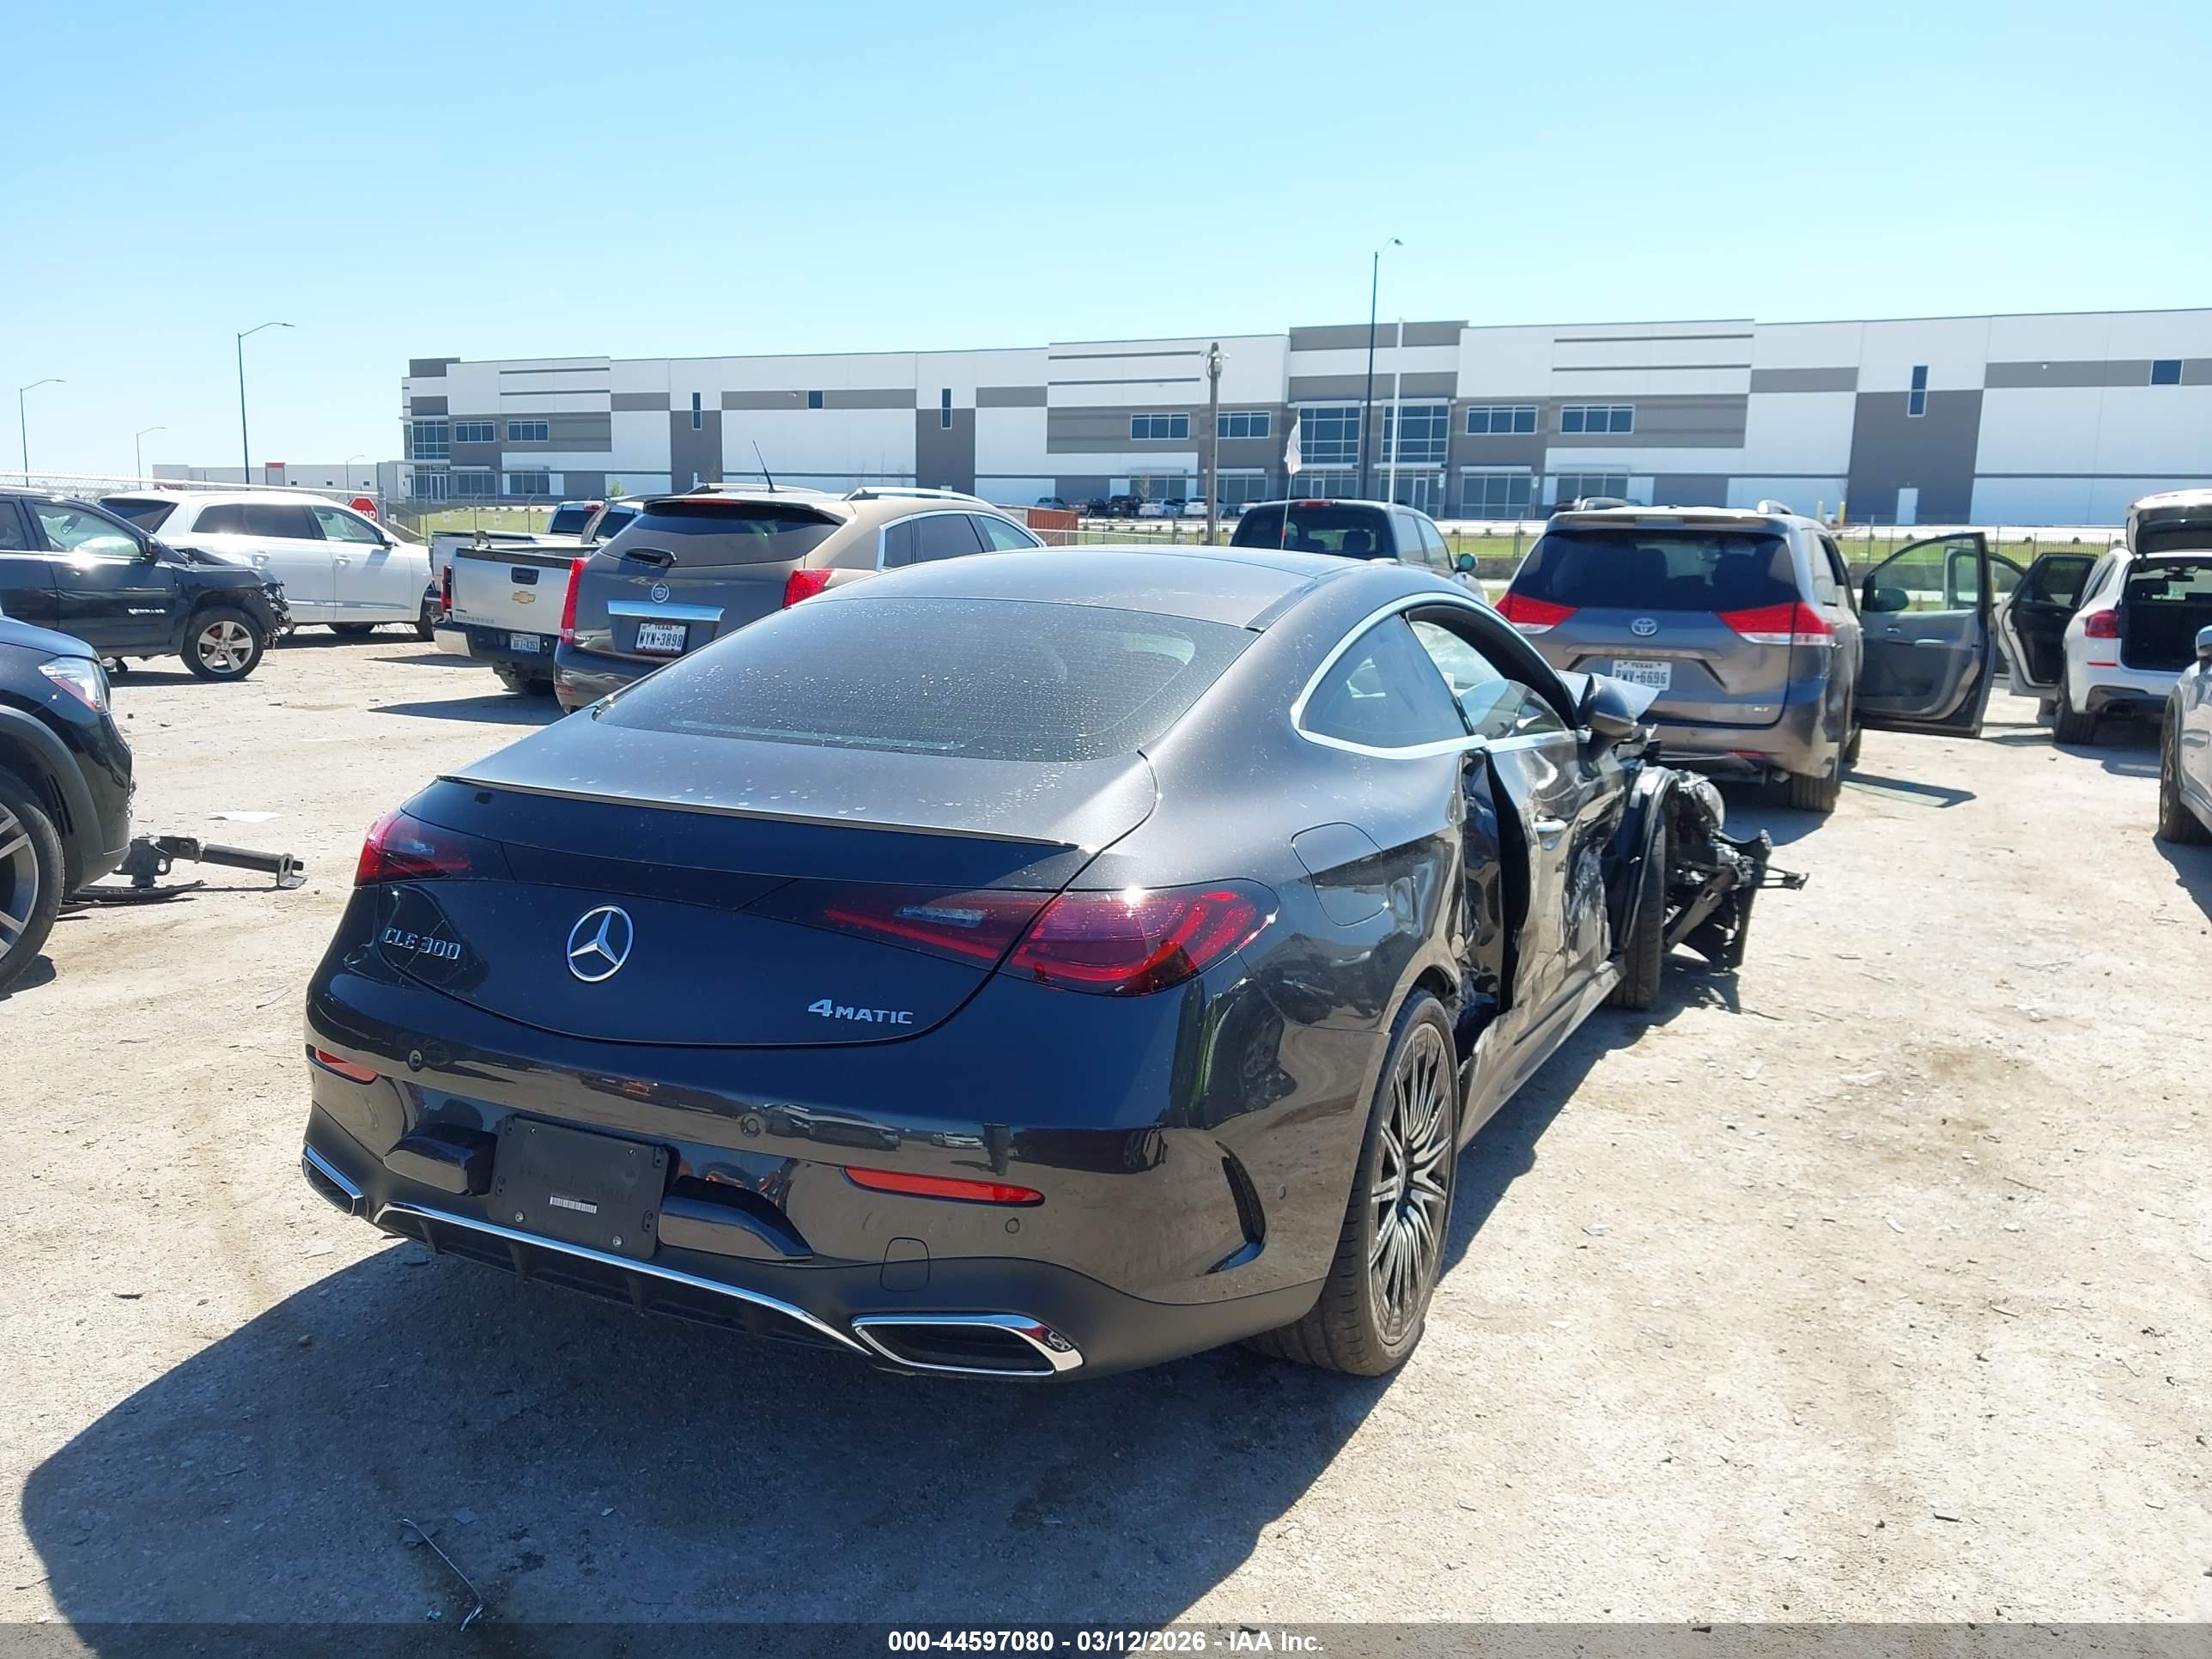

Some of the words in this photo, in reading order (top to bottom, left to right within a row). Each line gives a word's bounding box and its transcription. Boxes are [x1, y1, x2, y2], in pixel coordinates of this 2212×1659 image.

[384, 927, 418, 950] CLE
[418, 936, 461, 960] 300
[807, 999, 915, 1024] 4MATIC
